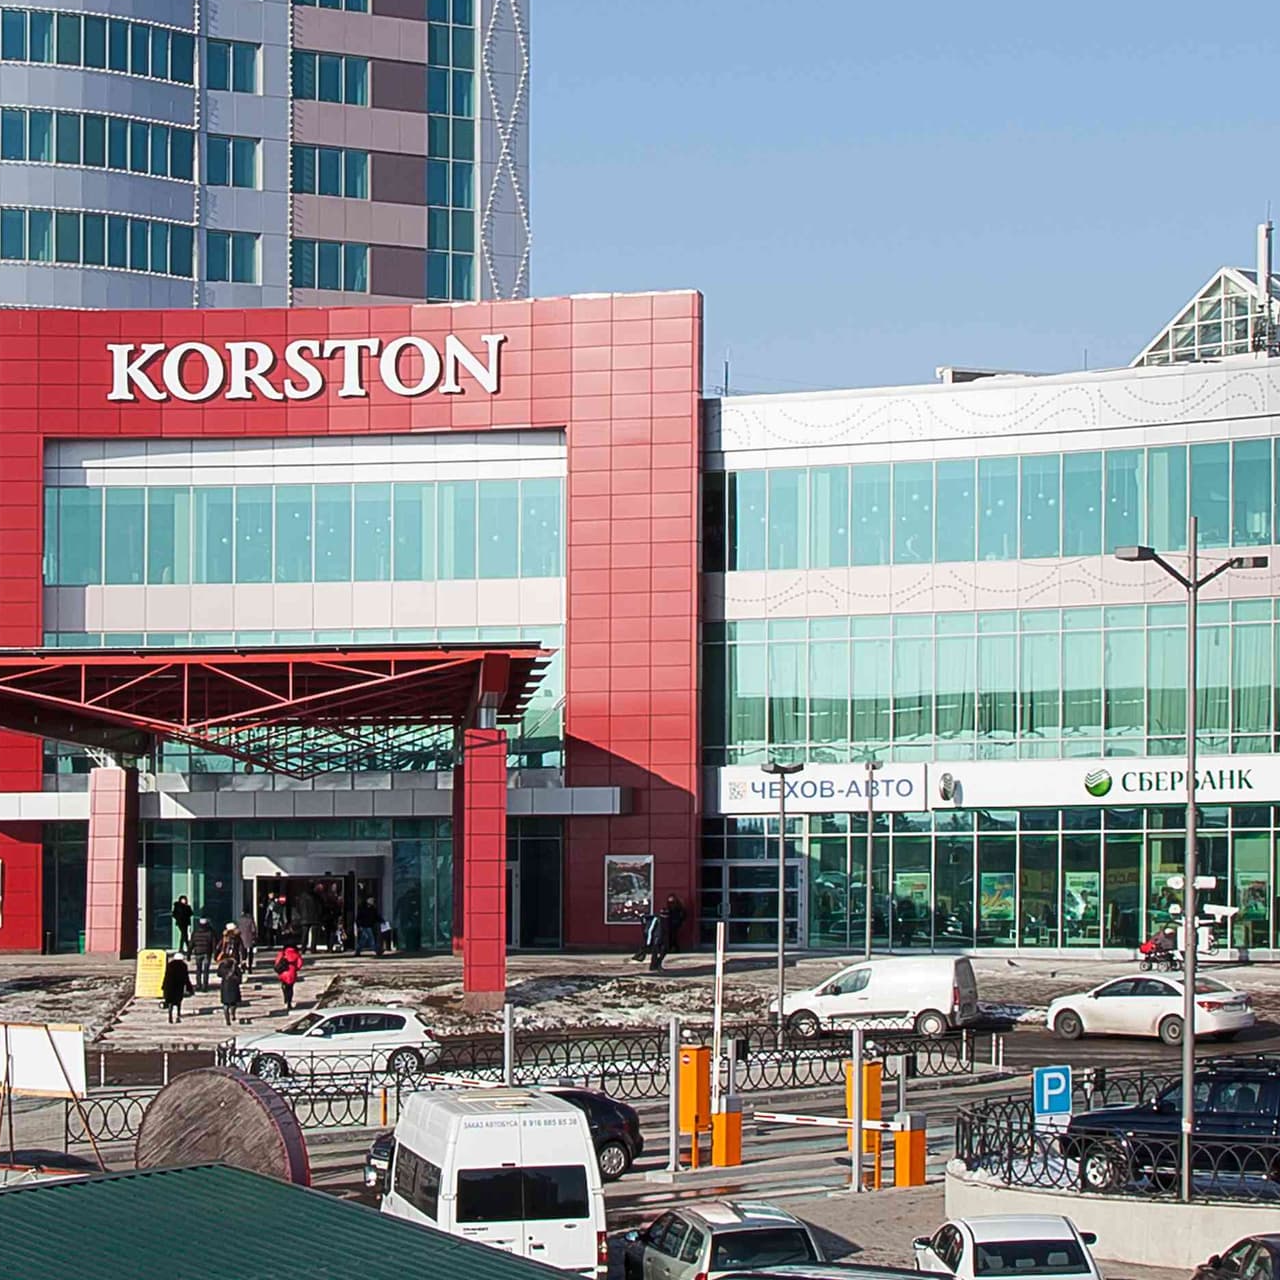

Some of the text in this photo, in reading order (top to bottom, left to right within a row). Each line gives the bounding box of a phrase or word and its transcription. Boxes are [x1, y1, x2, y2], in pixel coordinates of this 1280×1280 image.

[106, 333, 506, 402] KORSTON
[750, 778, 914, 800] ЧЕХОВ-АВТО
[1043, 1072, 1066, 1110] P
